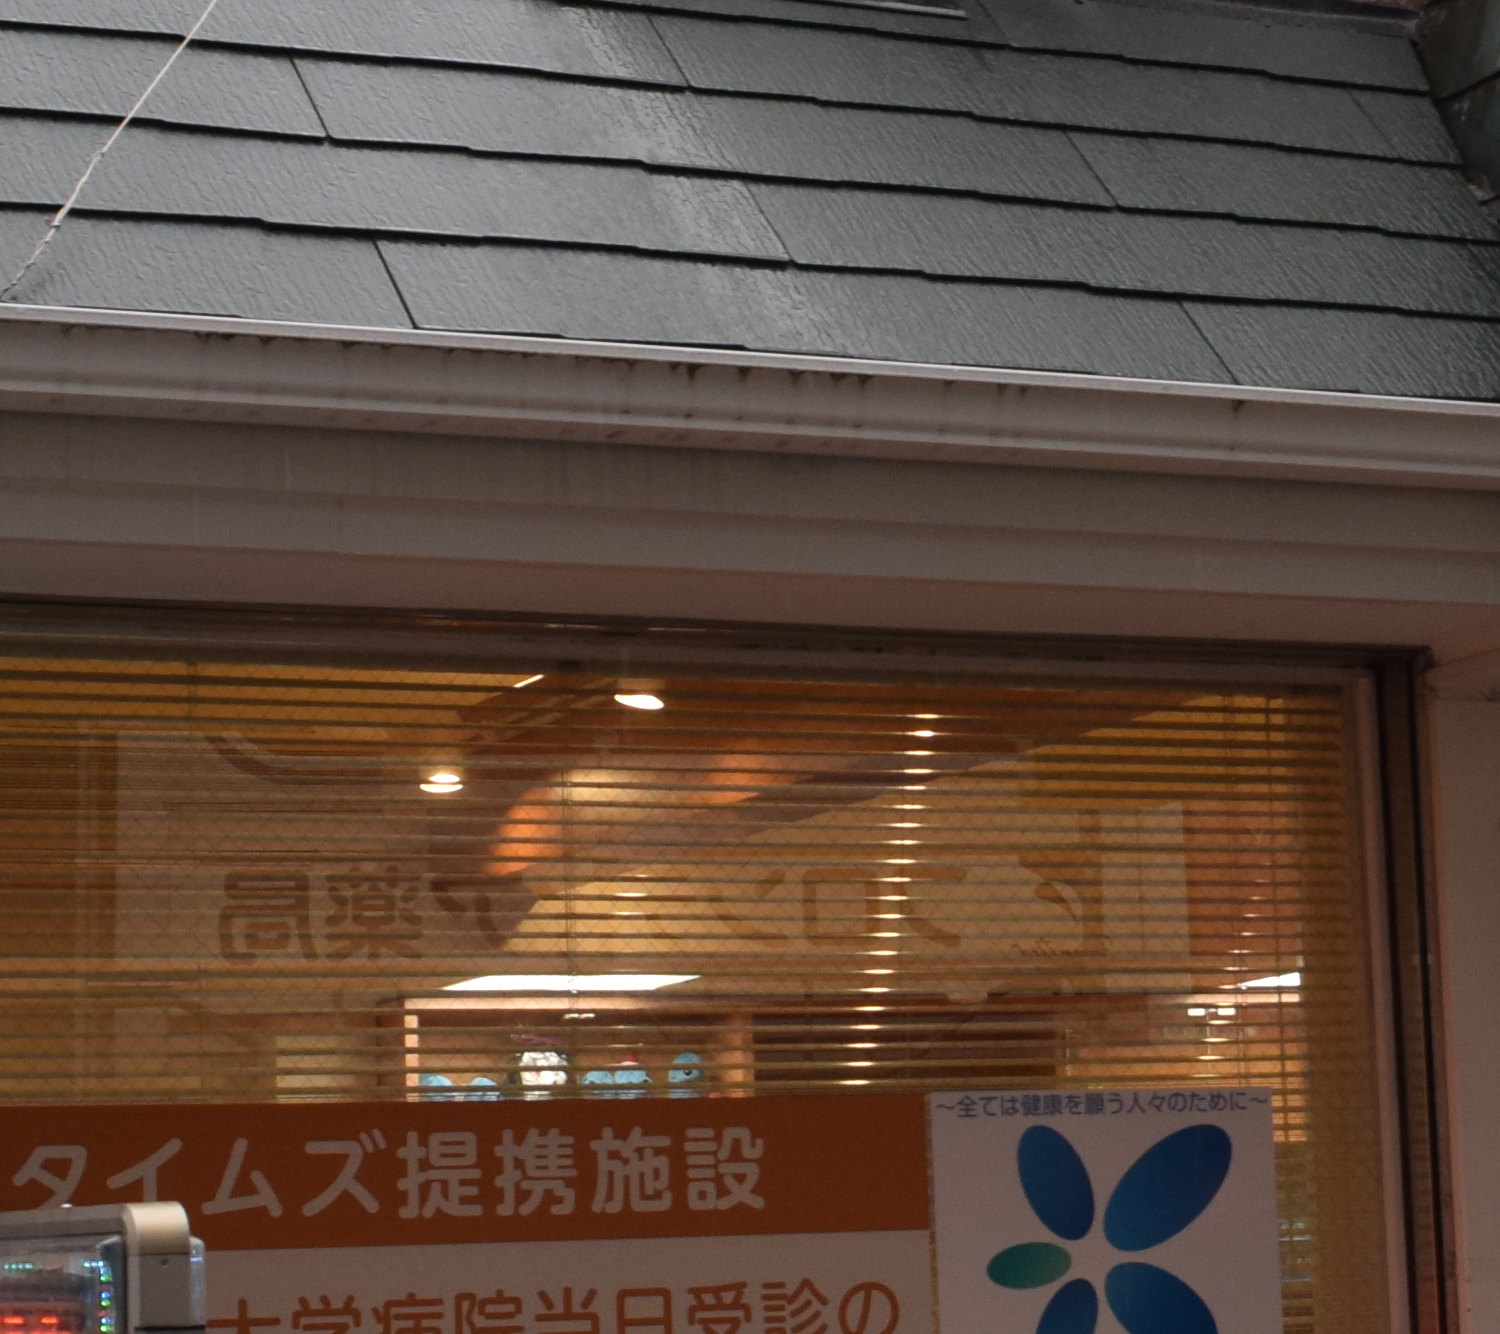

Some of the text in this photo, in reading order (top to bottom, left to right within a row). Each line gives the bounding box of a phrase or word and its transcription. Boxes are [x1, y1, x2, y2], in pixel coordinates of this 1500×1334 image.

[10, 1126, 767, 1220] タイムズ提携施設
